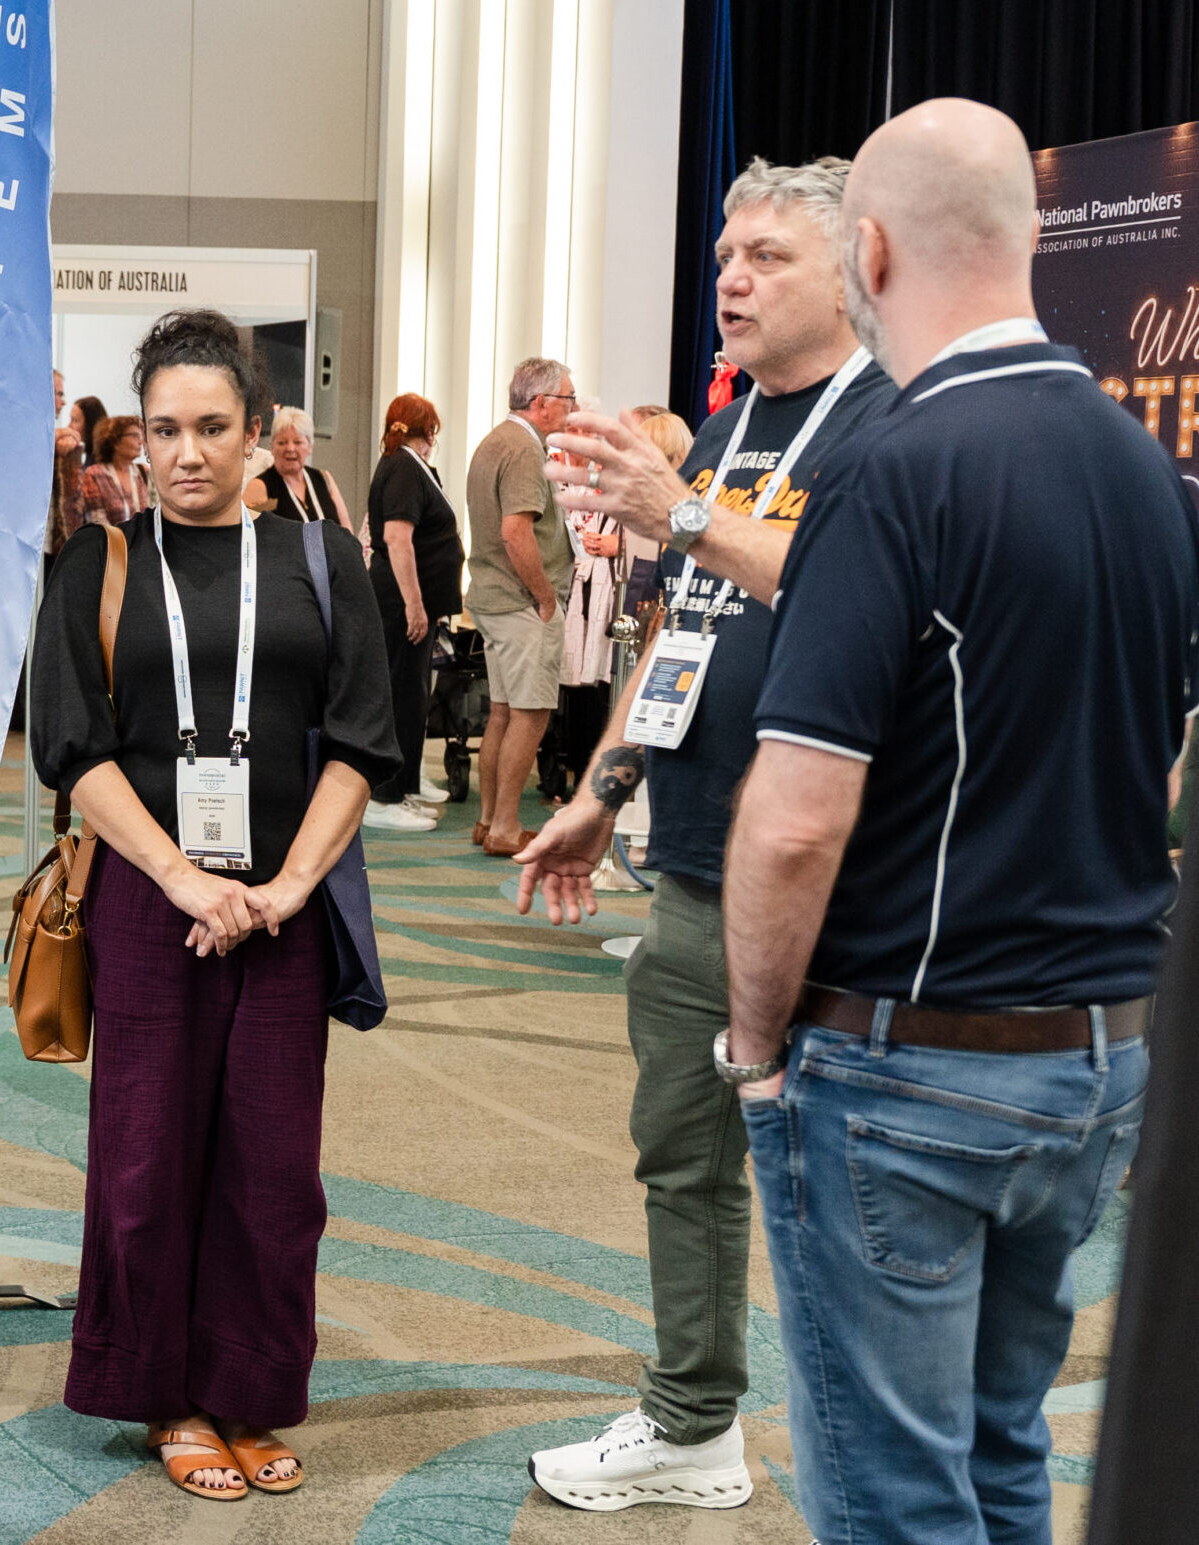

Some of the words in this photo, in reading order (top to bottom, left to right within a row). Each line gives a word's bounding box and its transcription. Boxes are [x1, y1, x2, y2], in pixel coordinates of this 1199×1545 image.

[1036, 203, 1088, 228] National
[1091, 191, 1183, 221] Pawnbrokers
[1092, 235, 1104, 248] OF
[1106, 229, 1158, 246] AUSTRALIA
[1161, 226, 1182, 240] INC.
[98, 270, 113, 290] OF
[118, 271, 188, 292] AUSTRALIA
[728, 451, 782, 471] NTAGE
